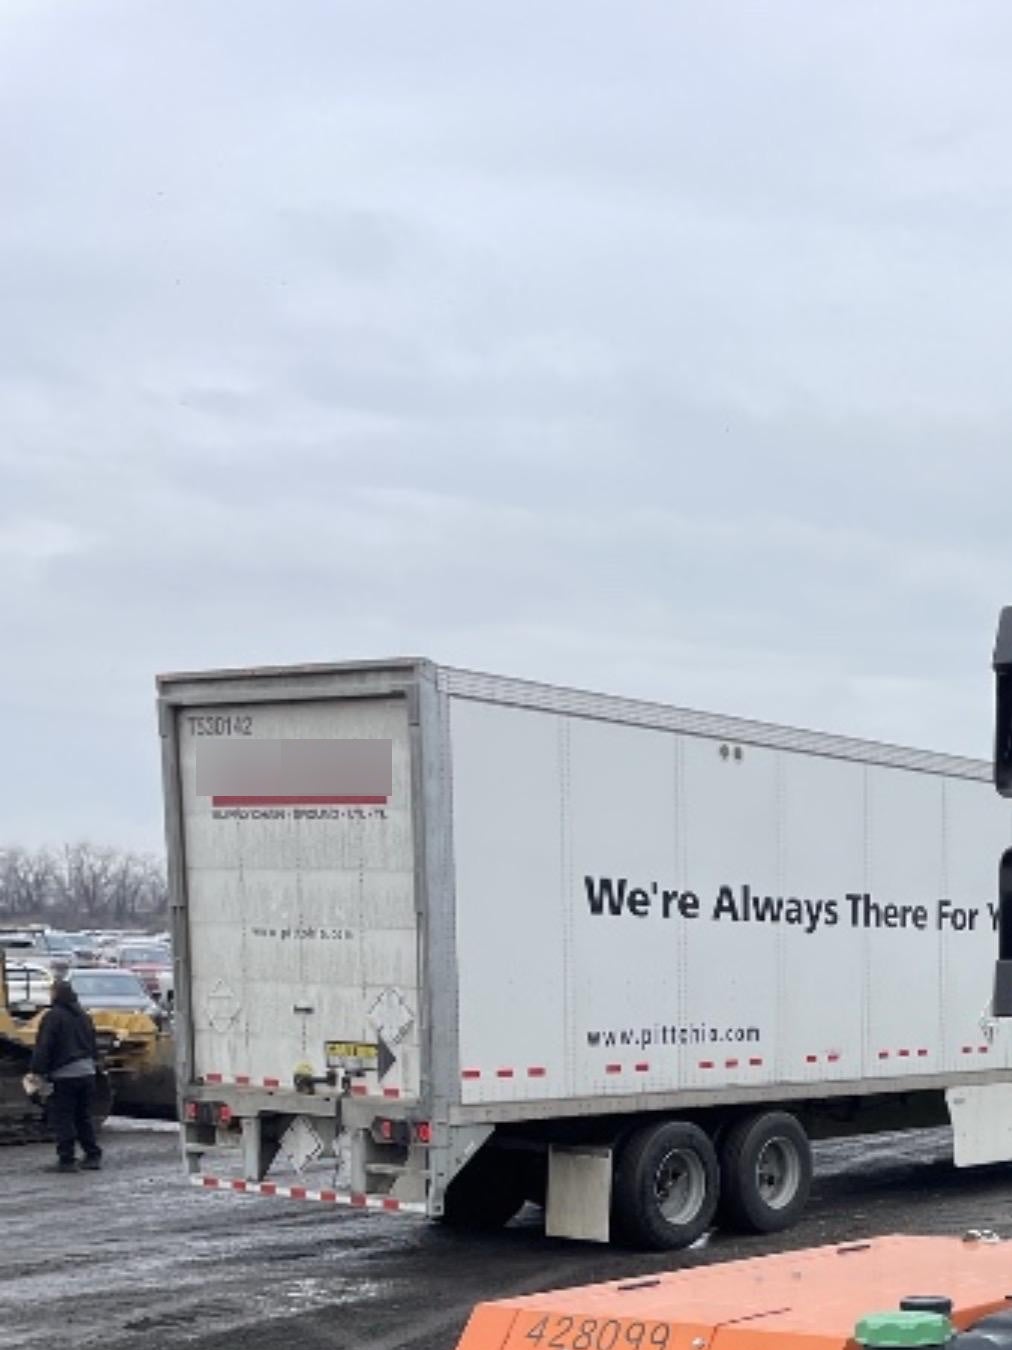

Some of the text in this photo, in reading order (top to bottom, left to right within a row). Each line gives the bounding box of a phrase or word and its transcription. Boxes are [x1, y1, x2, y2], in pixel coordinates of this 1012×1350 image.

[584, 875, 700, 919] We're
[712, 884, 839, 934] Always
[845, 892, 928, 931] There
[937, 899, 979, 932] For
